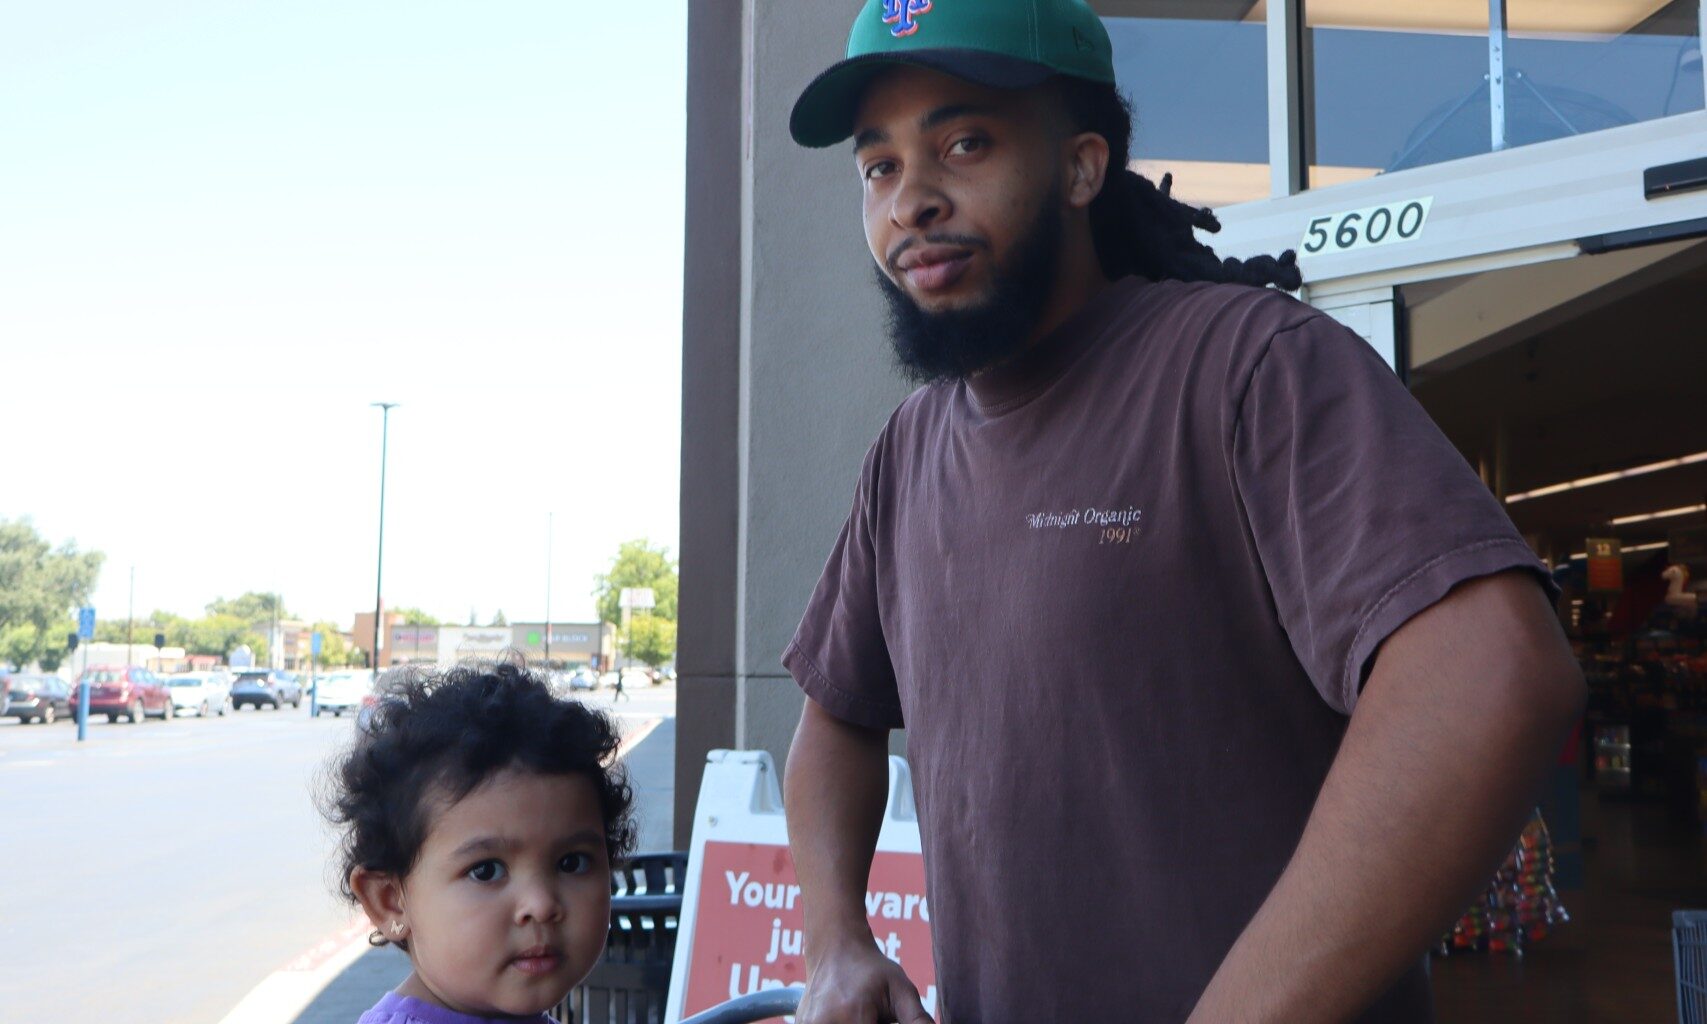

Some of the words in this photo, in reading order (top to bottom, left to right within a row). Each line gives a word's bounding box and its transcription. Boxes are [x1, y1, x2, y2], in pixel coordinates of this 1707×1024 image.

[1304, 202, 1424, 253] 5600
[1026, 509, 1080, 529] Midnight
[1084, 506, 1142, 527] Organic
[725, 870, 801, 910] Your
